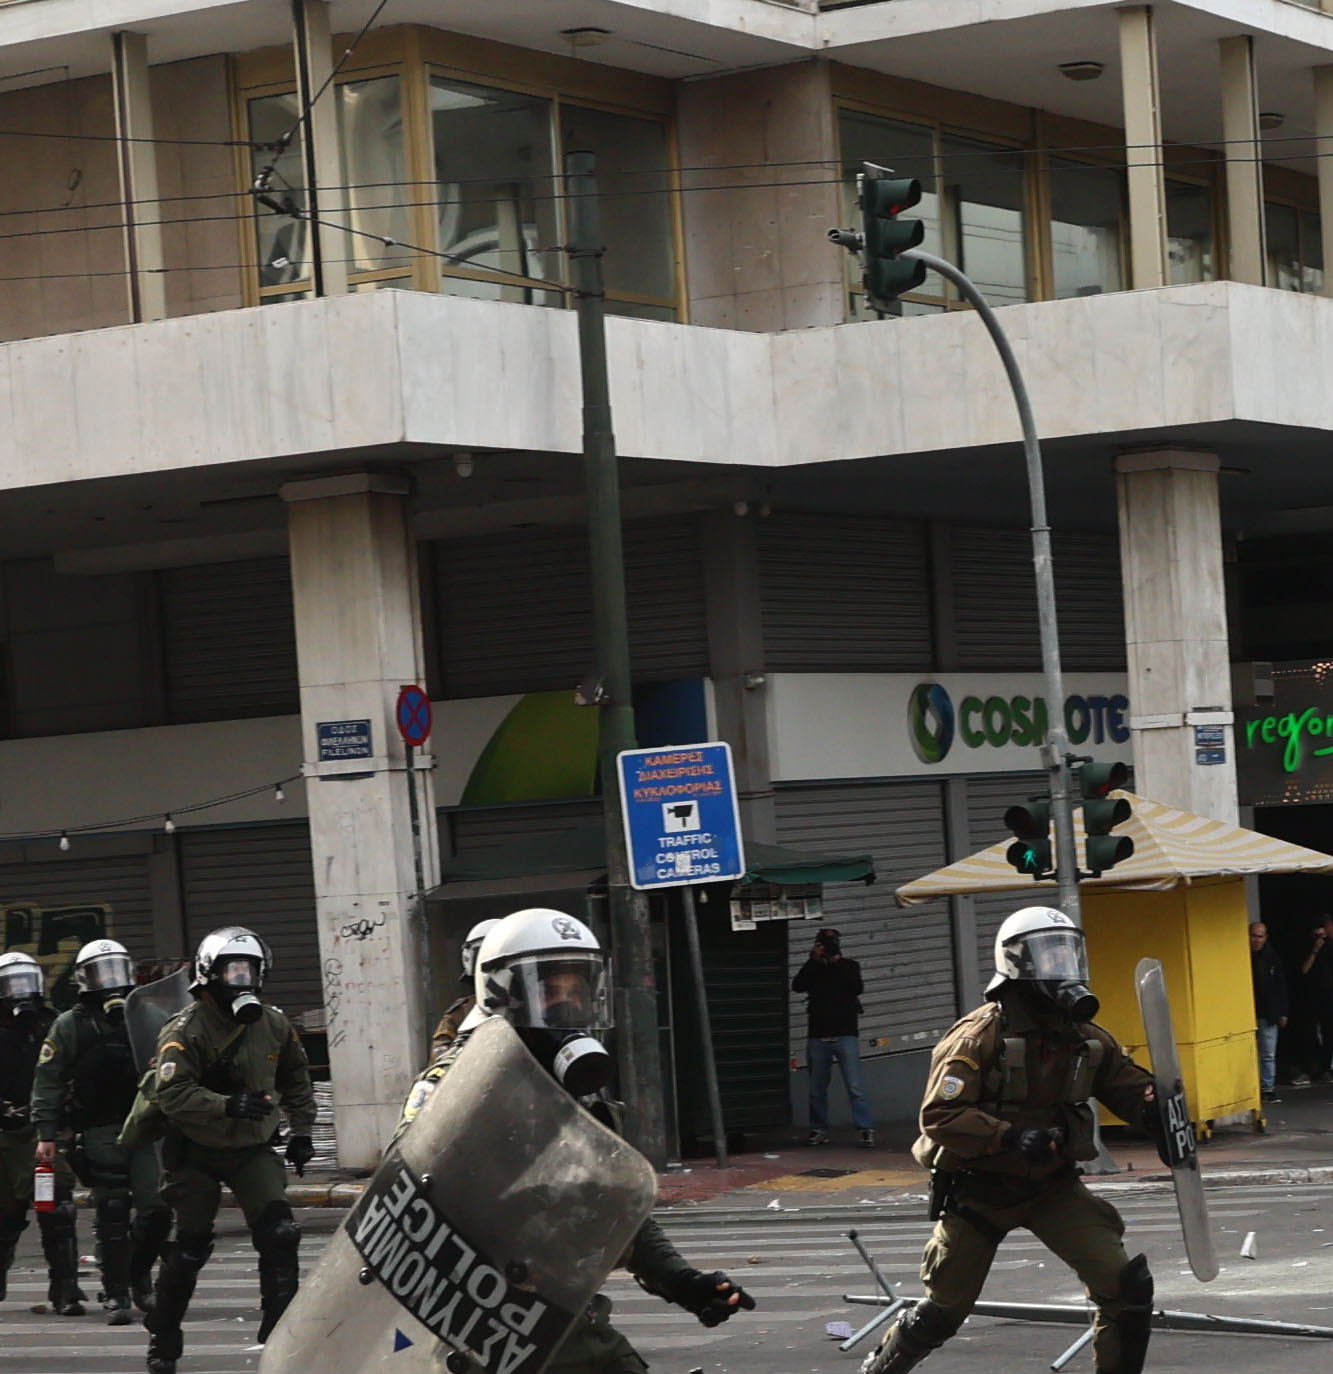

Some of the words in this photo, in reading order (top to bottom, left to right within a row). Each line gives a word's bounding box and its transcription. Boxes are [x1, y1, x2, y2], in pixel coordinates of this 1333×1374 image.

[645, 751, 704, 766] ΚΑΜΕΡΕΣ
[633, 780, 723, 798] ΚΥΚΛΟΦΟΡΙΑΣ
[658, 833, 712, 848] TRAFFIC
[656, 848, 718, 864] COROL
[657, 863, 720, 879] CAERAS
[384, 1169, 547, 1337] POLICE
